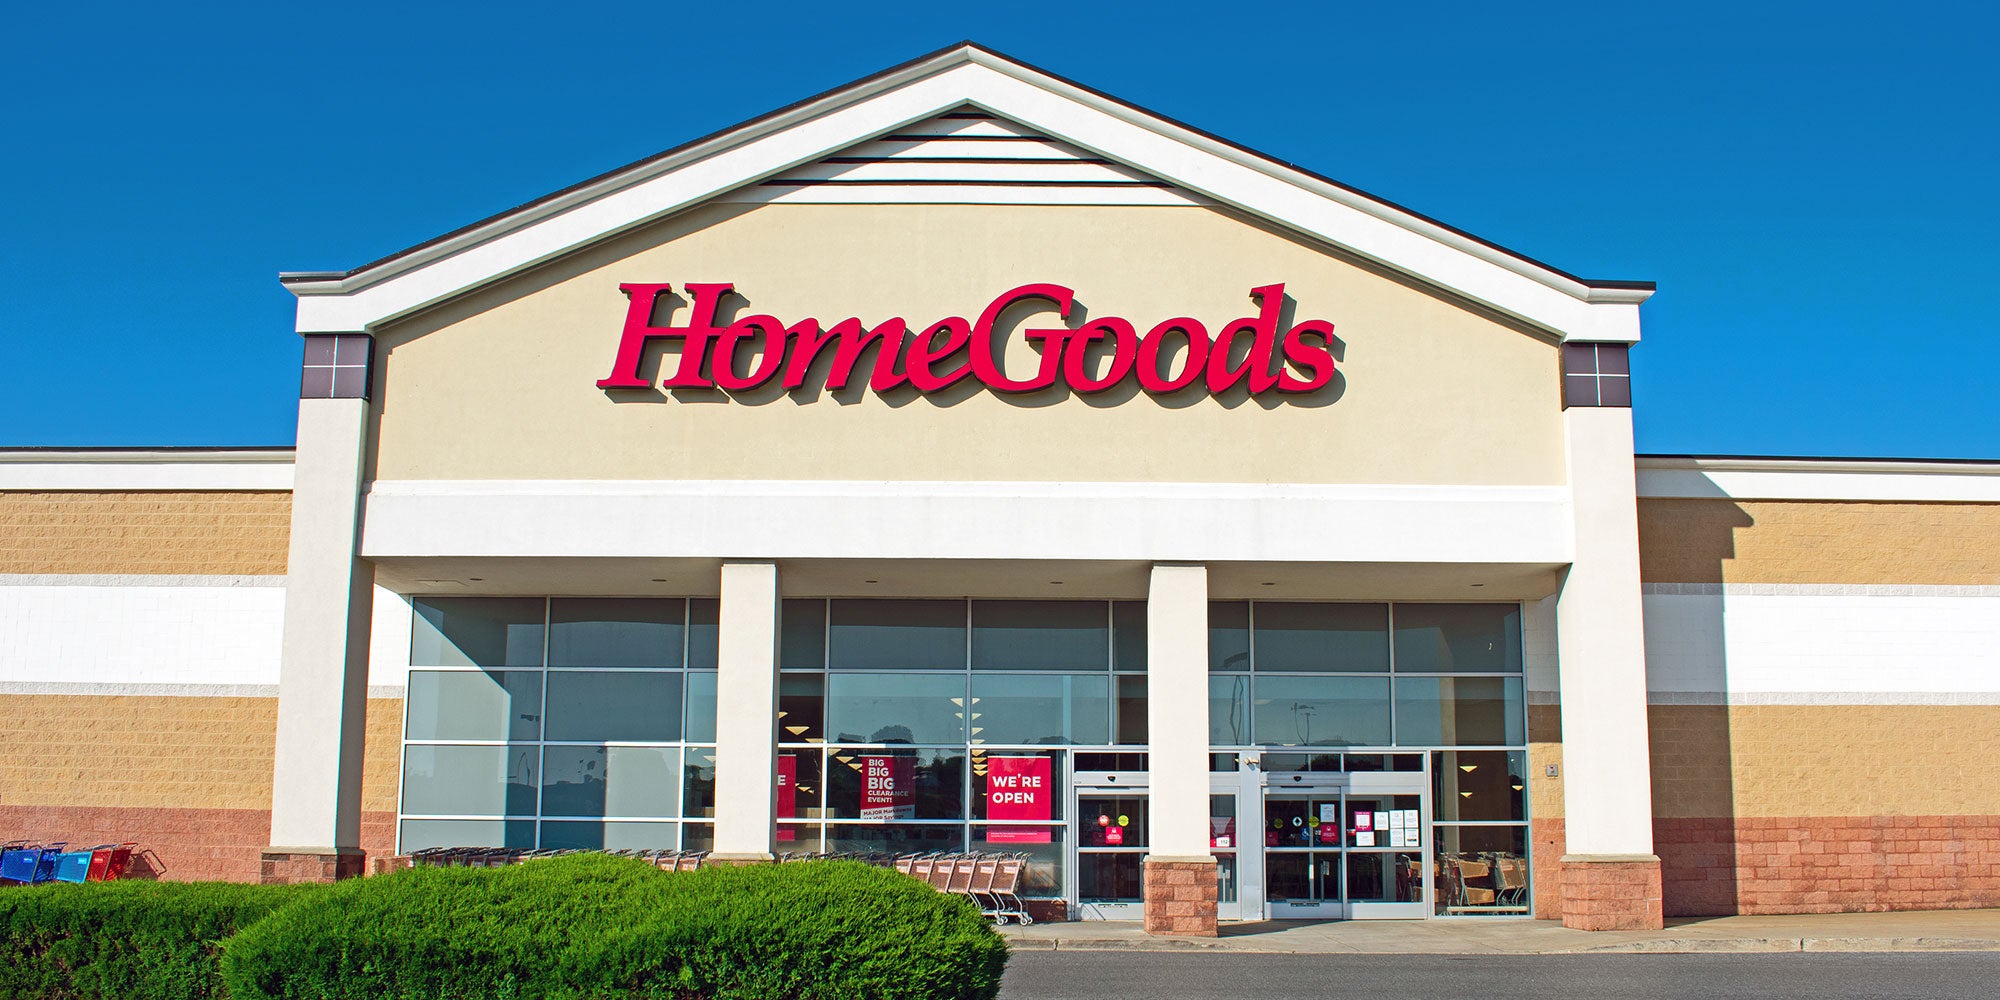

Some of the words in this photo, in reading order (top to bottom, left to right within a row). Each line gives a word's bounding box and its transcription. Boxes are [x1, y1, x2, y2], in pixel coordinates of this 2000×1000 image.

[597, 282, 1337, 394] HomeGoods
[868, 767, 889, 777] BIG
[868, 777, 895, 790] BIG
[992, 773, 1042, 788] WE'RE
[992, 792, 1035, 804] OPEN
